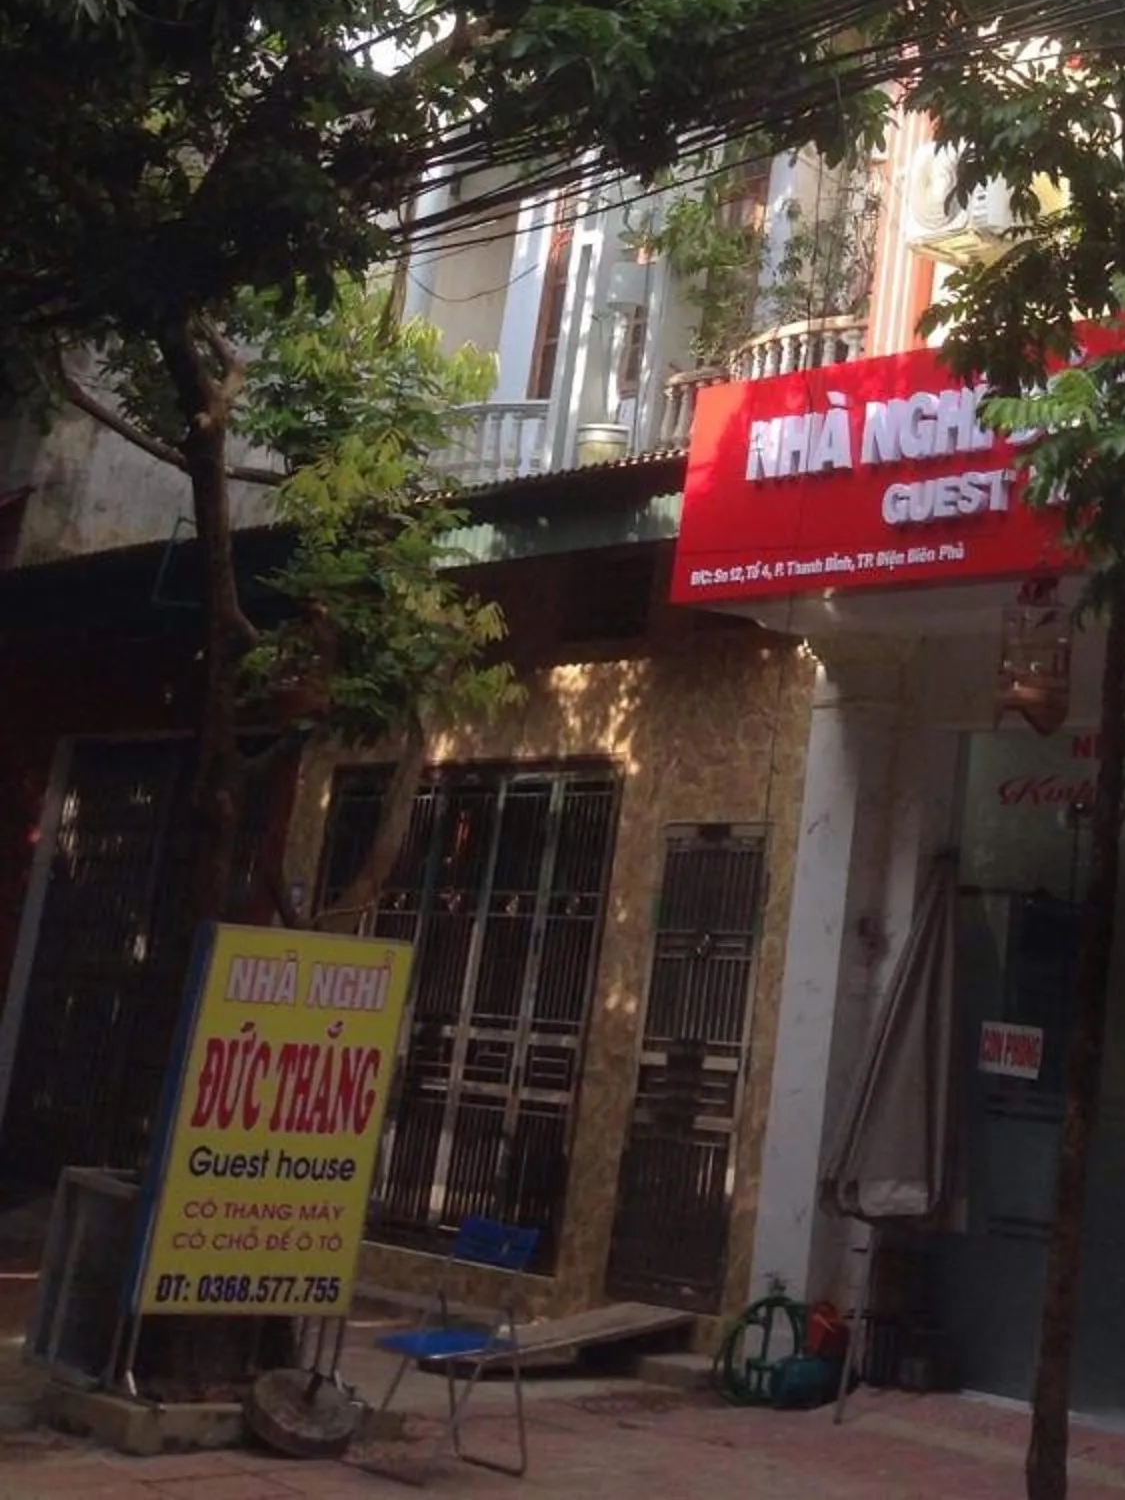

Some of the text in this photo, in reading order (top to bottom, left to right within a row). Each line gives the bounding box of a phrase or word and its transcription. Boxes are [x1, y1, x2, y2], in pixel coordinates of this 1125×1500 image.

[746, 391, 853, 481] NHÀ
[882, 468, 1017, 525] GUEST
[787, 558, 823, 576] Thanh
[223, 950, 395, 1012] NHÀ NGHỈ
[190, 1021, 382, 1135] ĐỨC THẮNG
[188, 1145, 357, 1181] Guest house
[224, 1201, 294, 1220] THANG
